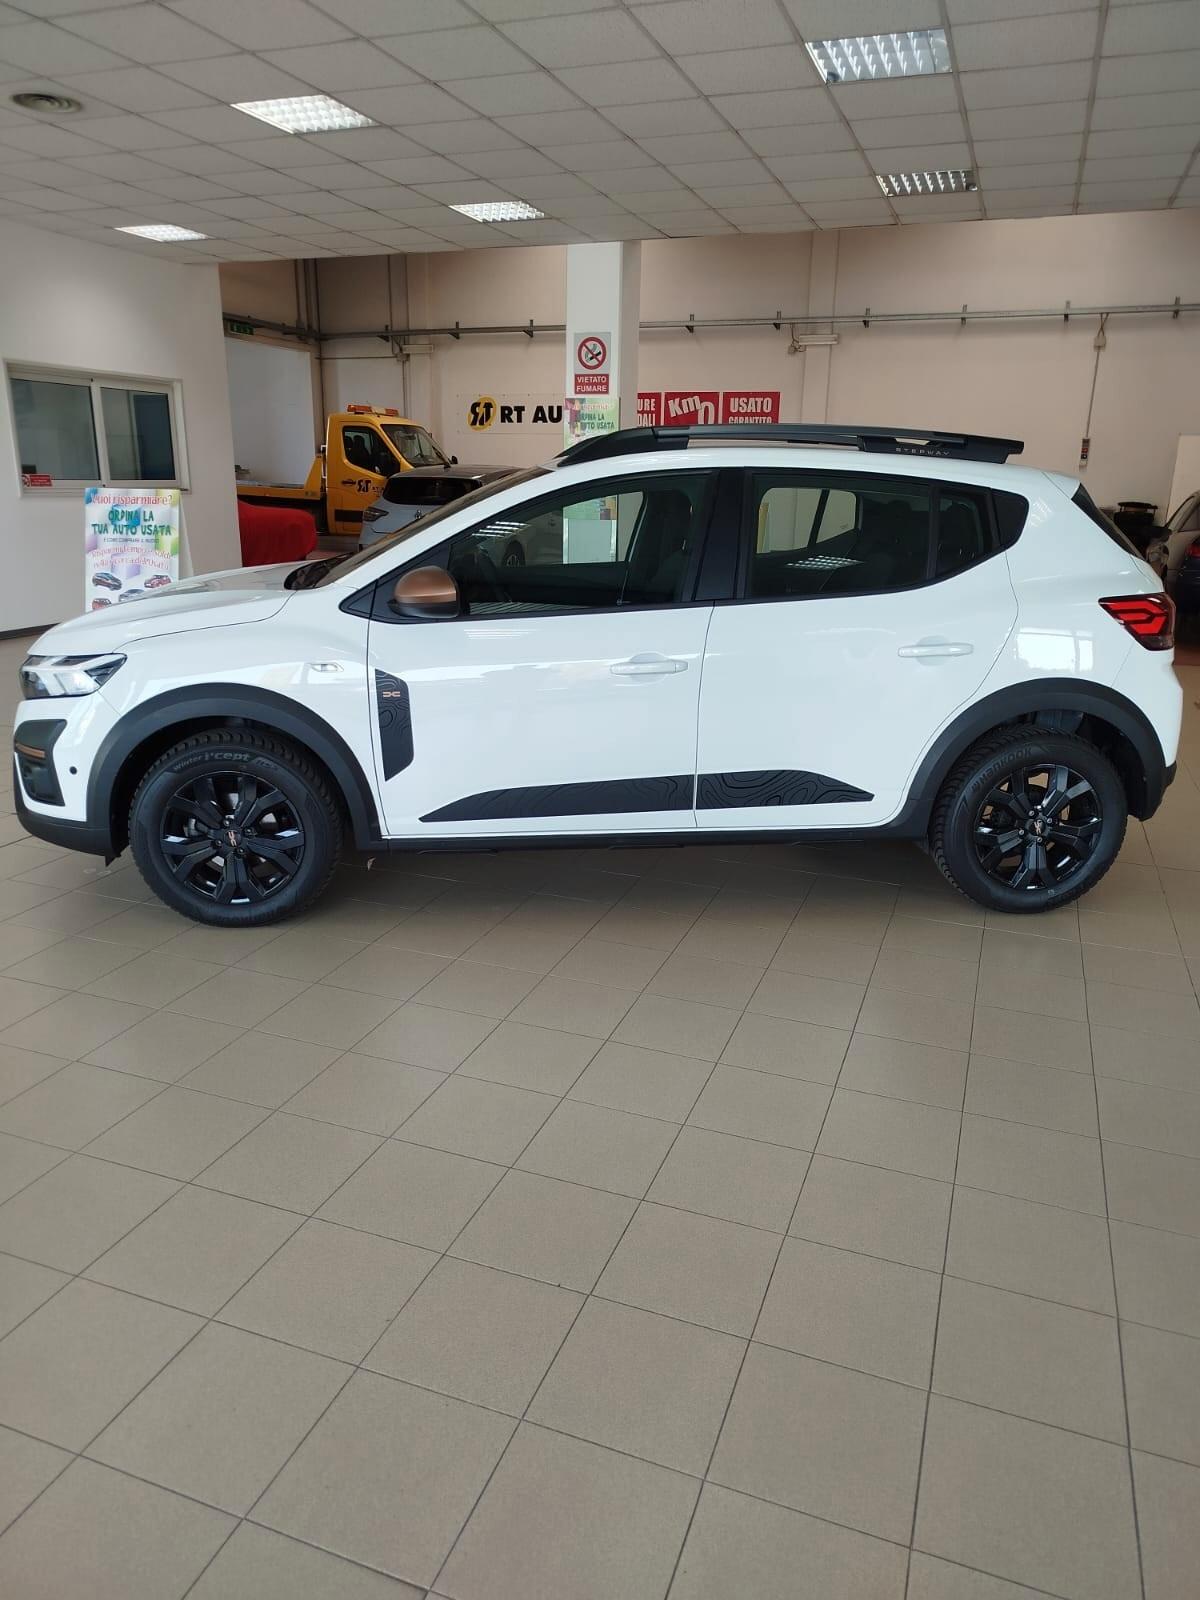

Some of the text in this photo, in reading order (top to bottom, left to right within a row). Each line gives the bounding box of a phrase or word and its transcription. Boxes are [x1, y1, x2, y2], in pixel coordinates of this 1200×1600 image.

[668, 395, 700, 418] Km
[729, 397, 772, 413] USATO
[500, 405, 526, 423] RT
[596, 422, 615, 430] USATA
[728, 416, 772, 425] GARANTITO
[895, 447, 951, 456] STEPWAY
[113, 494, 173, 506] risparmiare?
[143, 511, 154, 521] LA
[91, 523, 171, 536] TUA AUTO USATA
